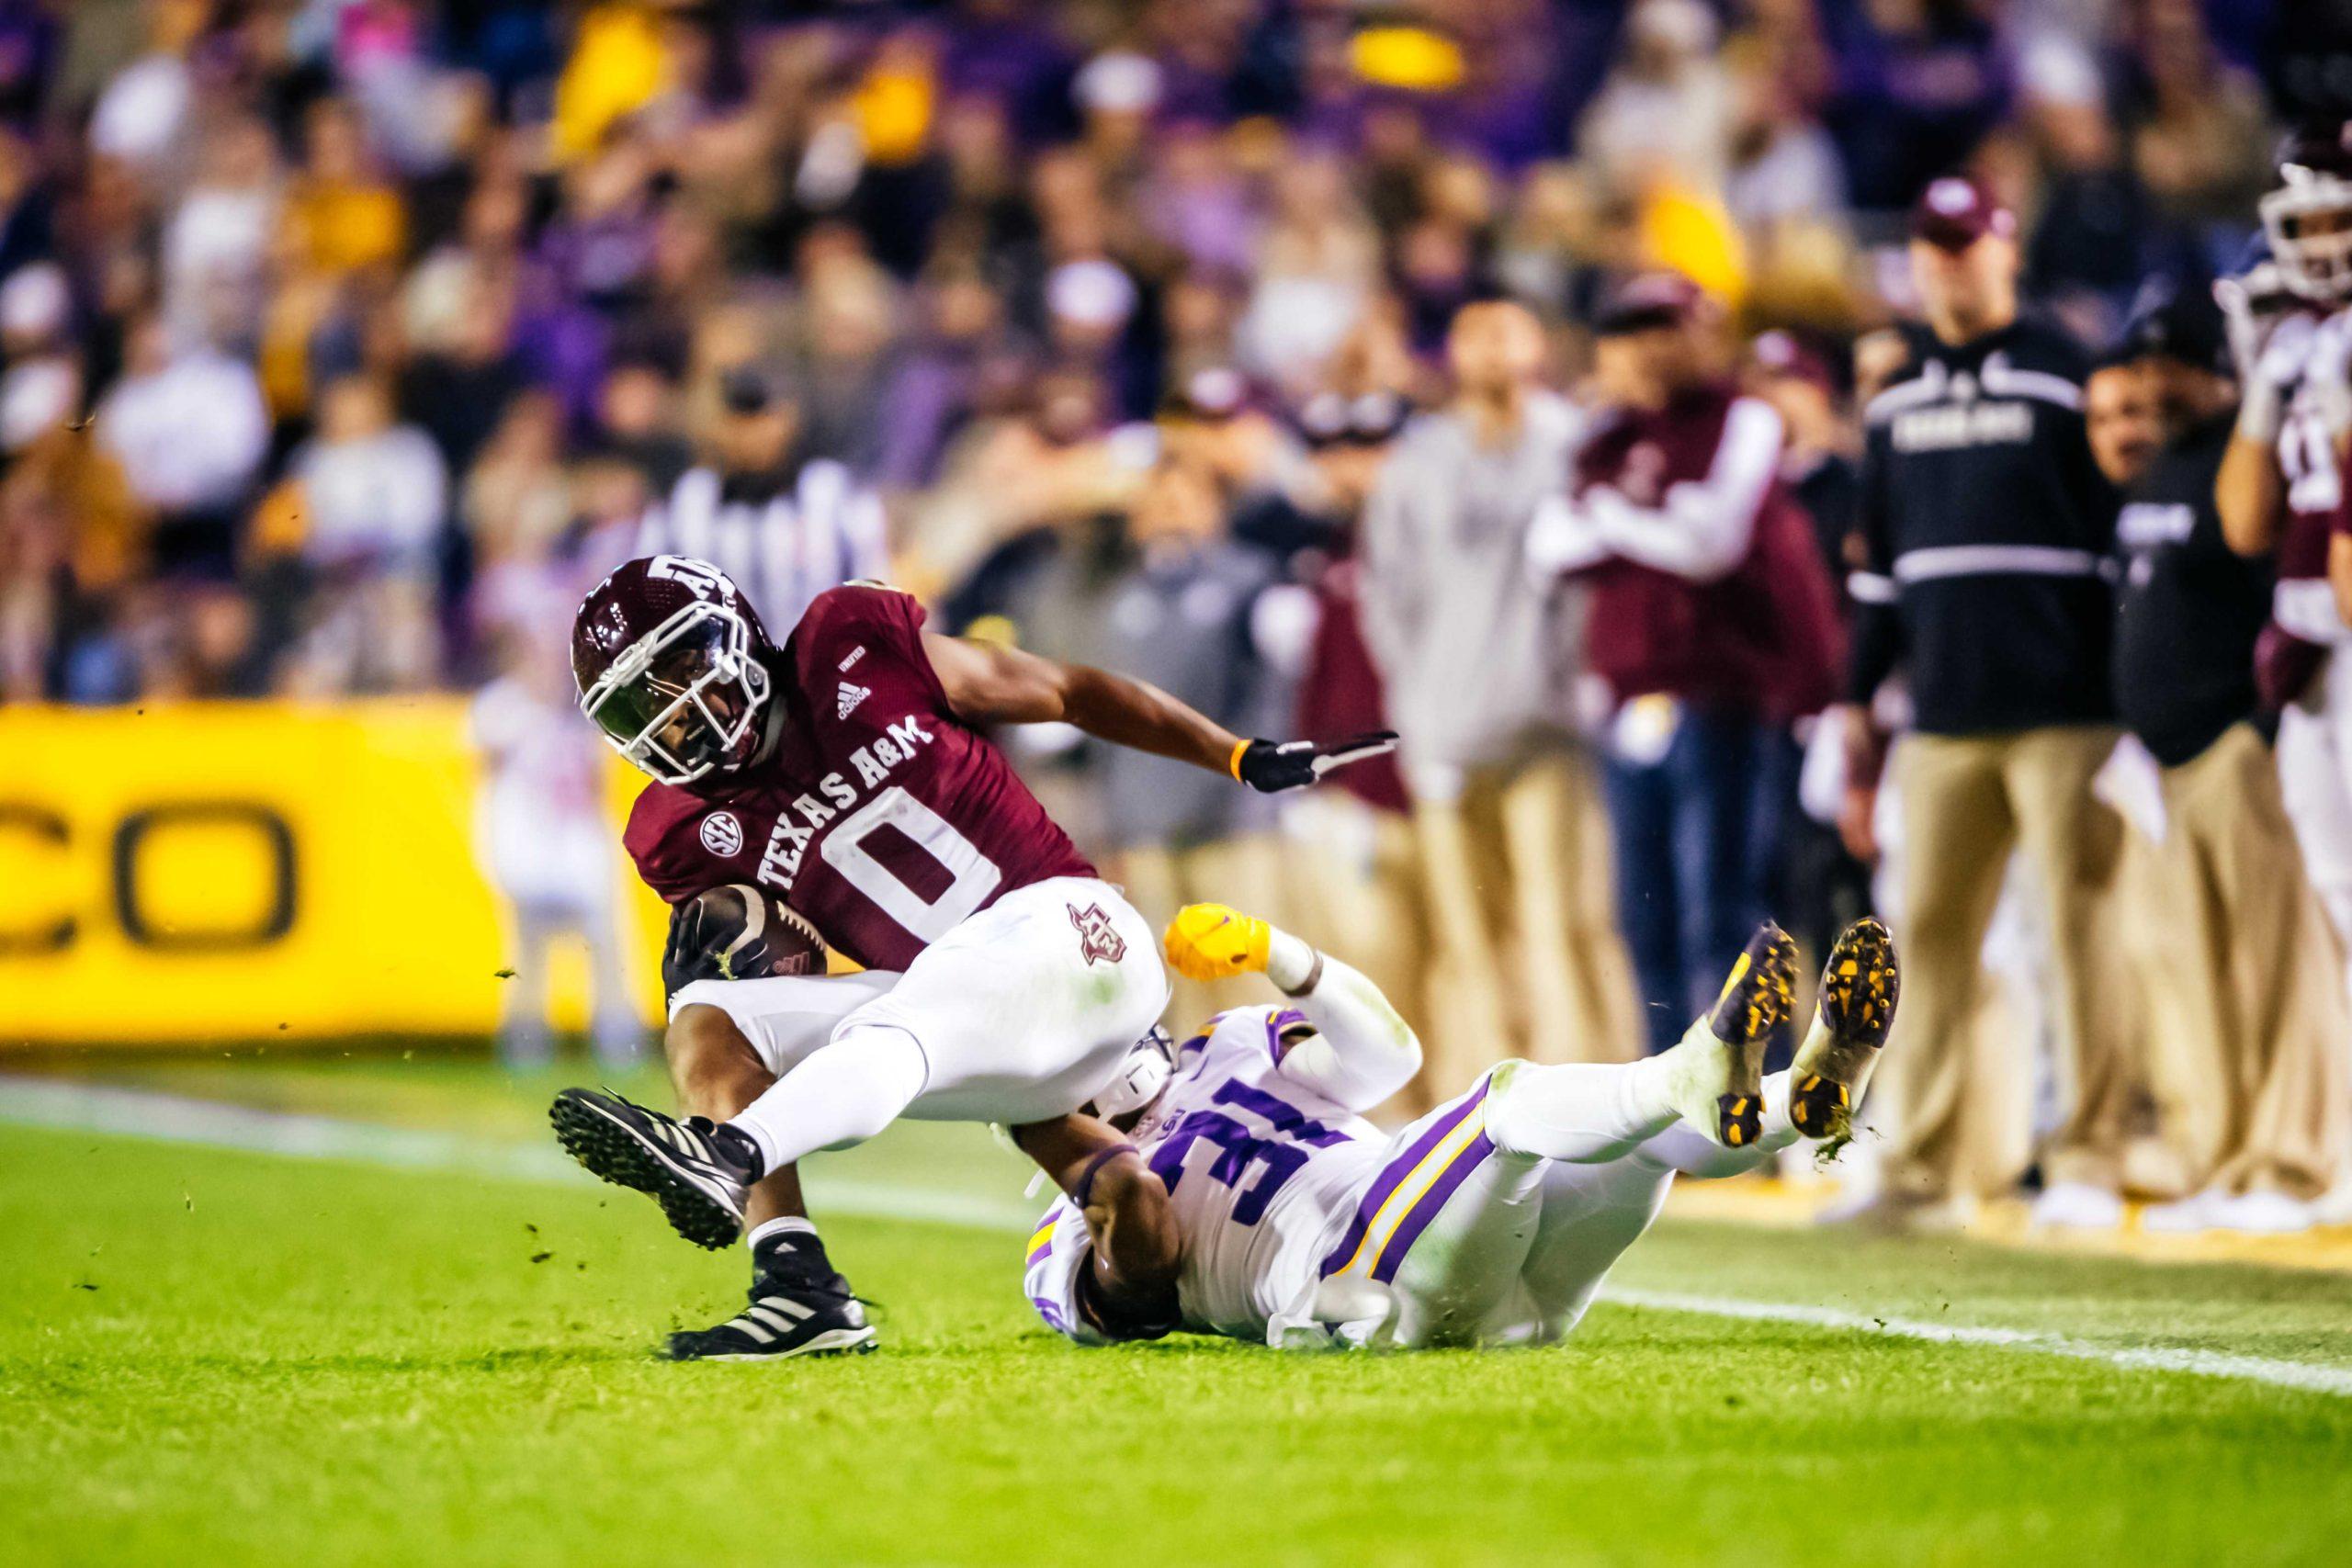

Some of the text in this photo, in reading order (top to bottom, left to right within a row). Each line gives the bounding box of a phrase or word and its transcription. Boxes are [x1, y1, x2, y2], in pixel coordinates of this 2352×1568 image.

[838, 686, 871, 720] adidas
[701, 813, 741, 855] SEC
[757, 715, 934, 890] TEXAS A&M
[820, 786, 1001, 944] 0
[1148, 1077, 1354, 1226] 31
